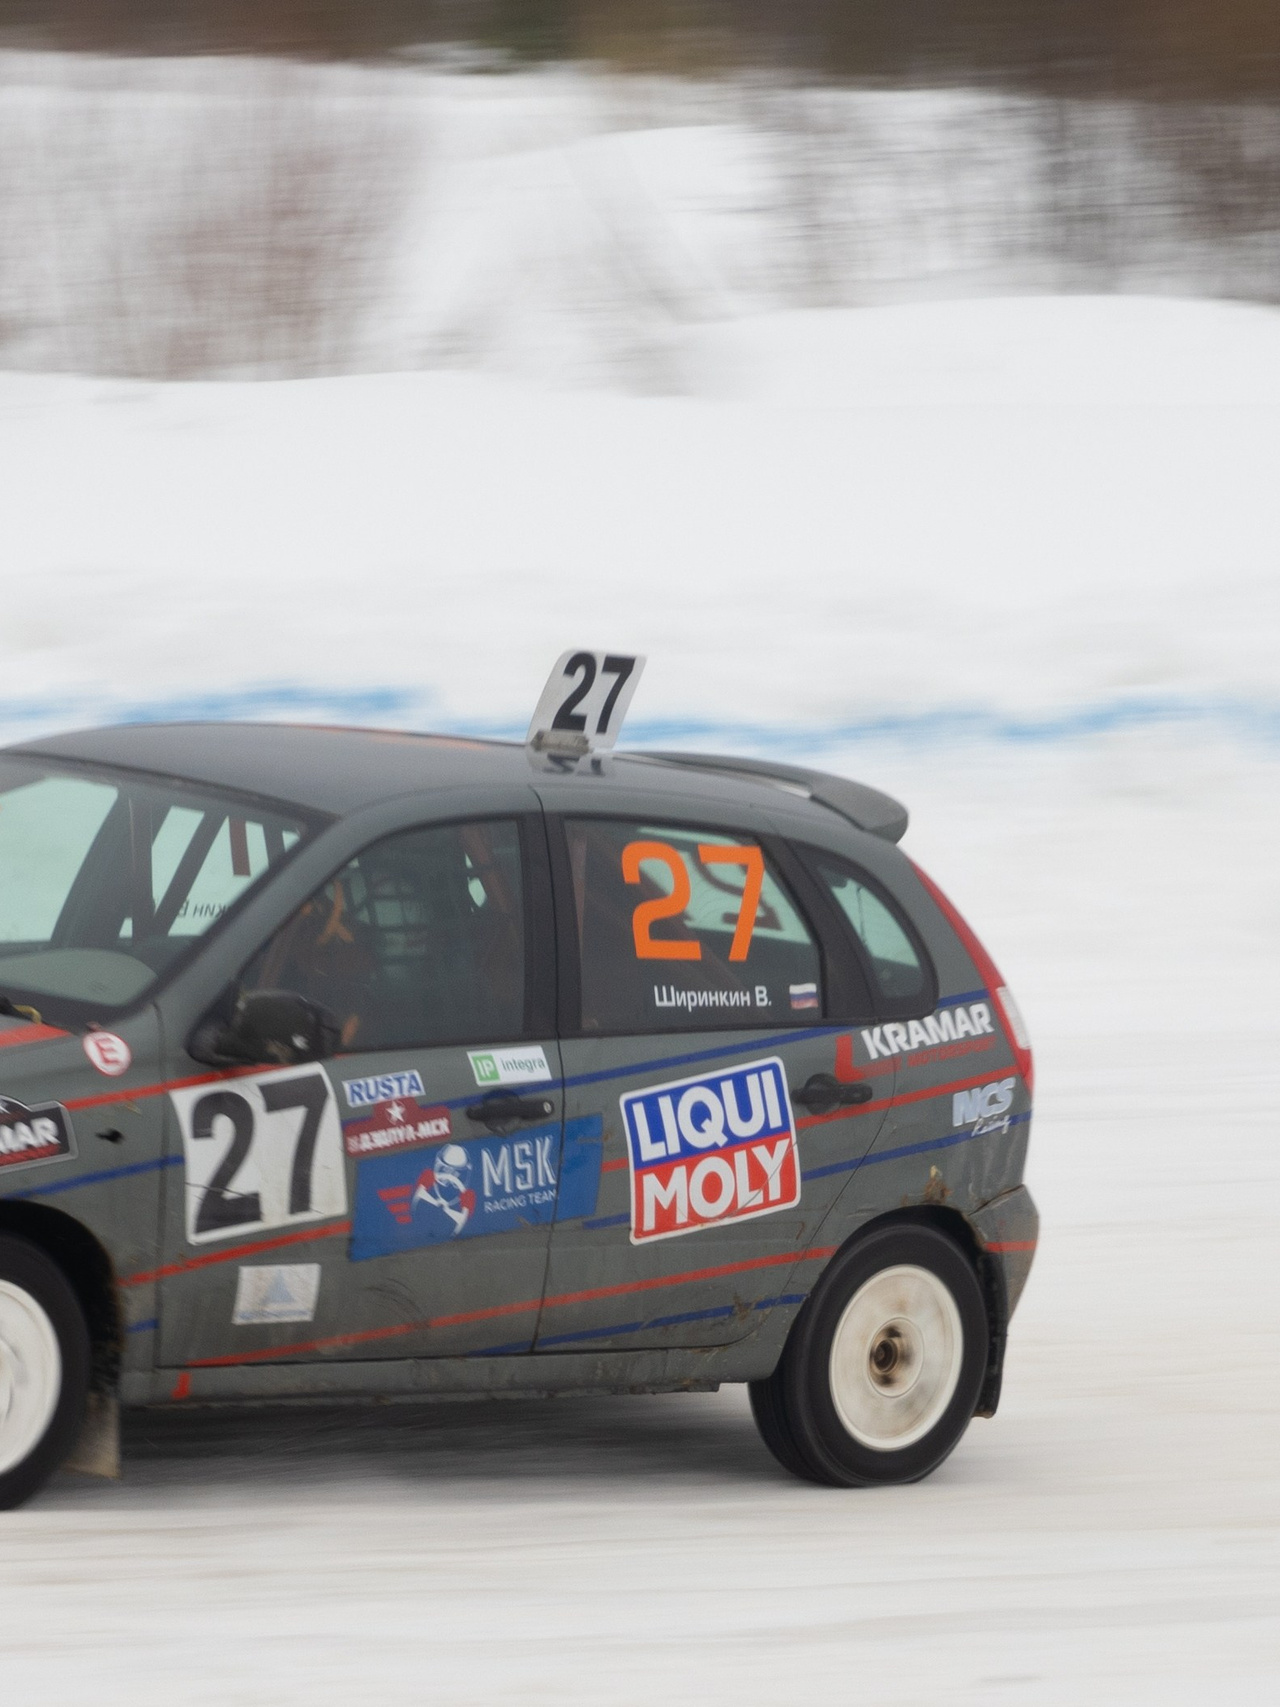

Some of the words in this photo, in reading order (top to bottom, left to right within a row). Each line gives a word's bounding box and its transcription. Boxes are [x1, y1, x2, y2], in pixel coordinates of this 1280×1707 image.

[551, 652, 636, 735] 27
[622, 841, 765, 962] 27
[654, 984, 751, 1013] Ширинкин
[861, 1003, 995, 1060] KRAMAR
[349, 1073, 424, 1104] RUSTA
[501, 1055, 546, 1074] integra
[631, 1069, 783, 1162] LIQUI
[192, 1073, 329, 1234] 27
[481, 1135, 558, 1198] MSK
[641, 1137, 791, 1232] MOLY
[484, 1195, 527, 1214] RACING
